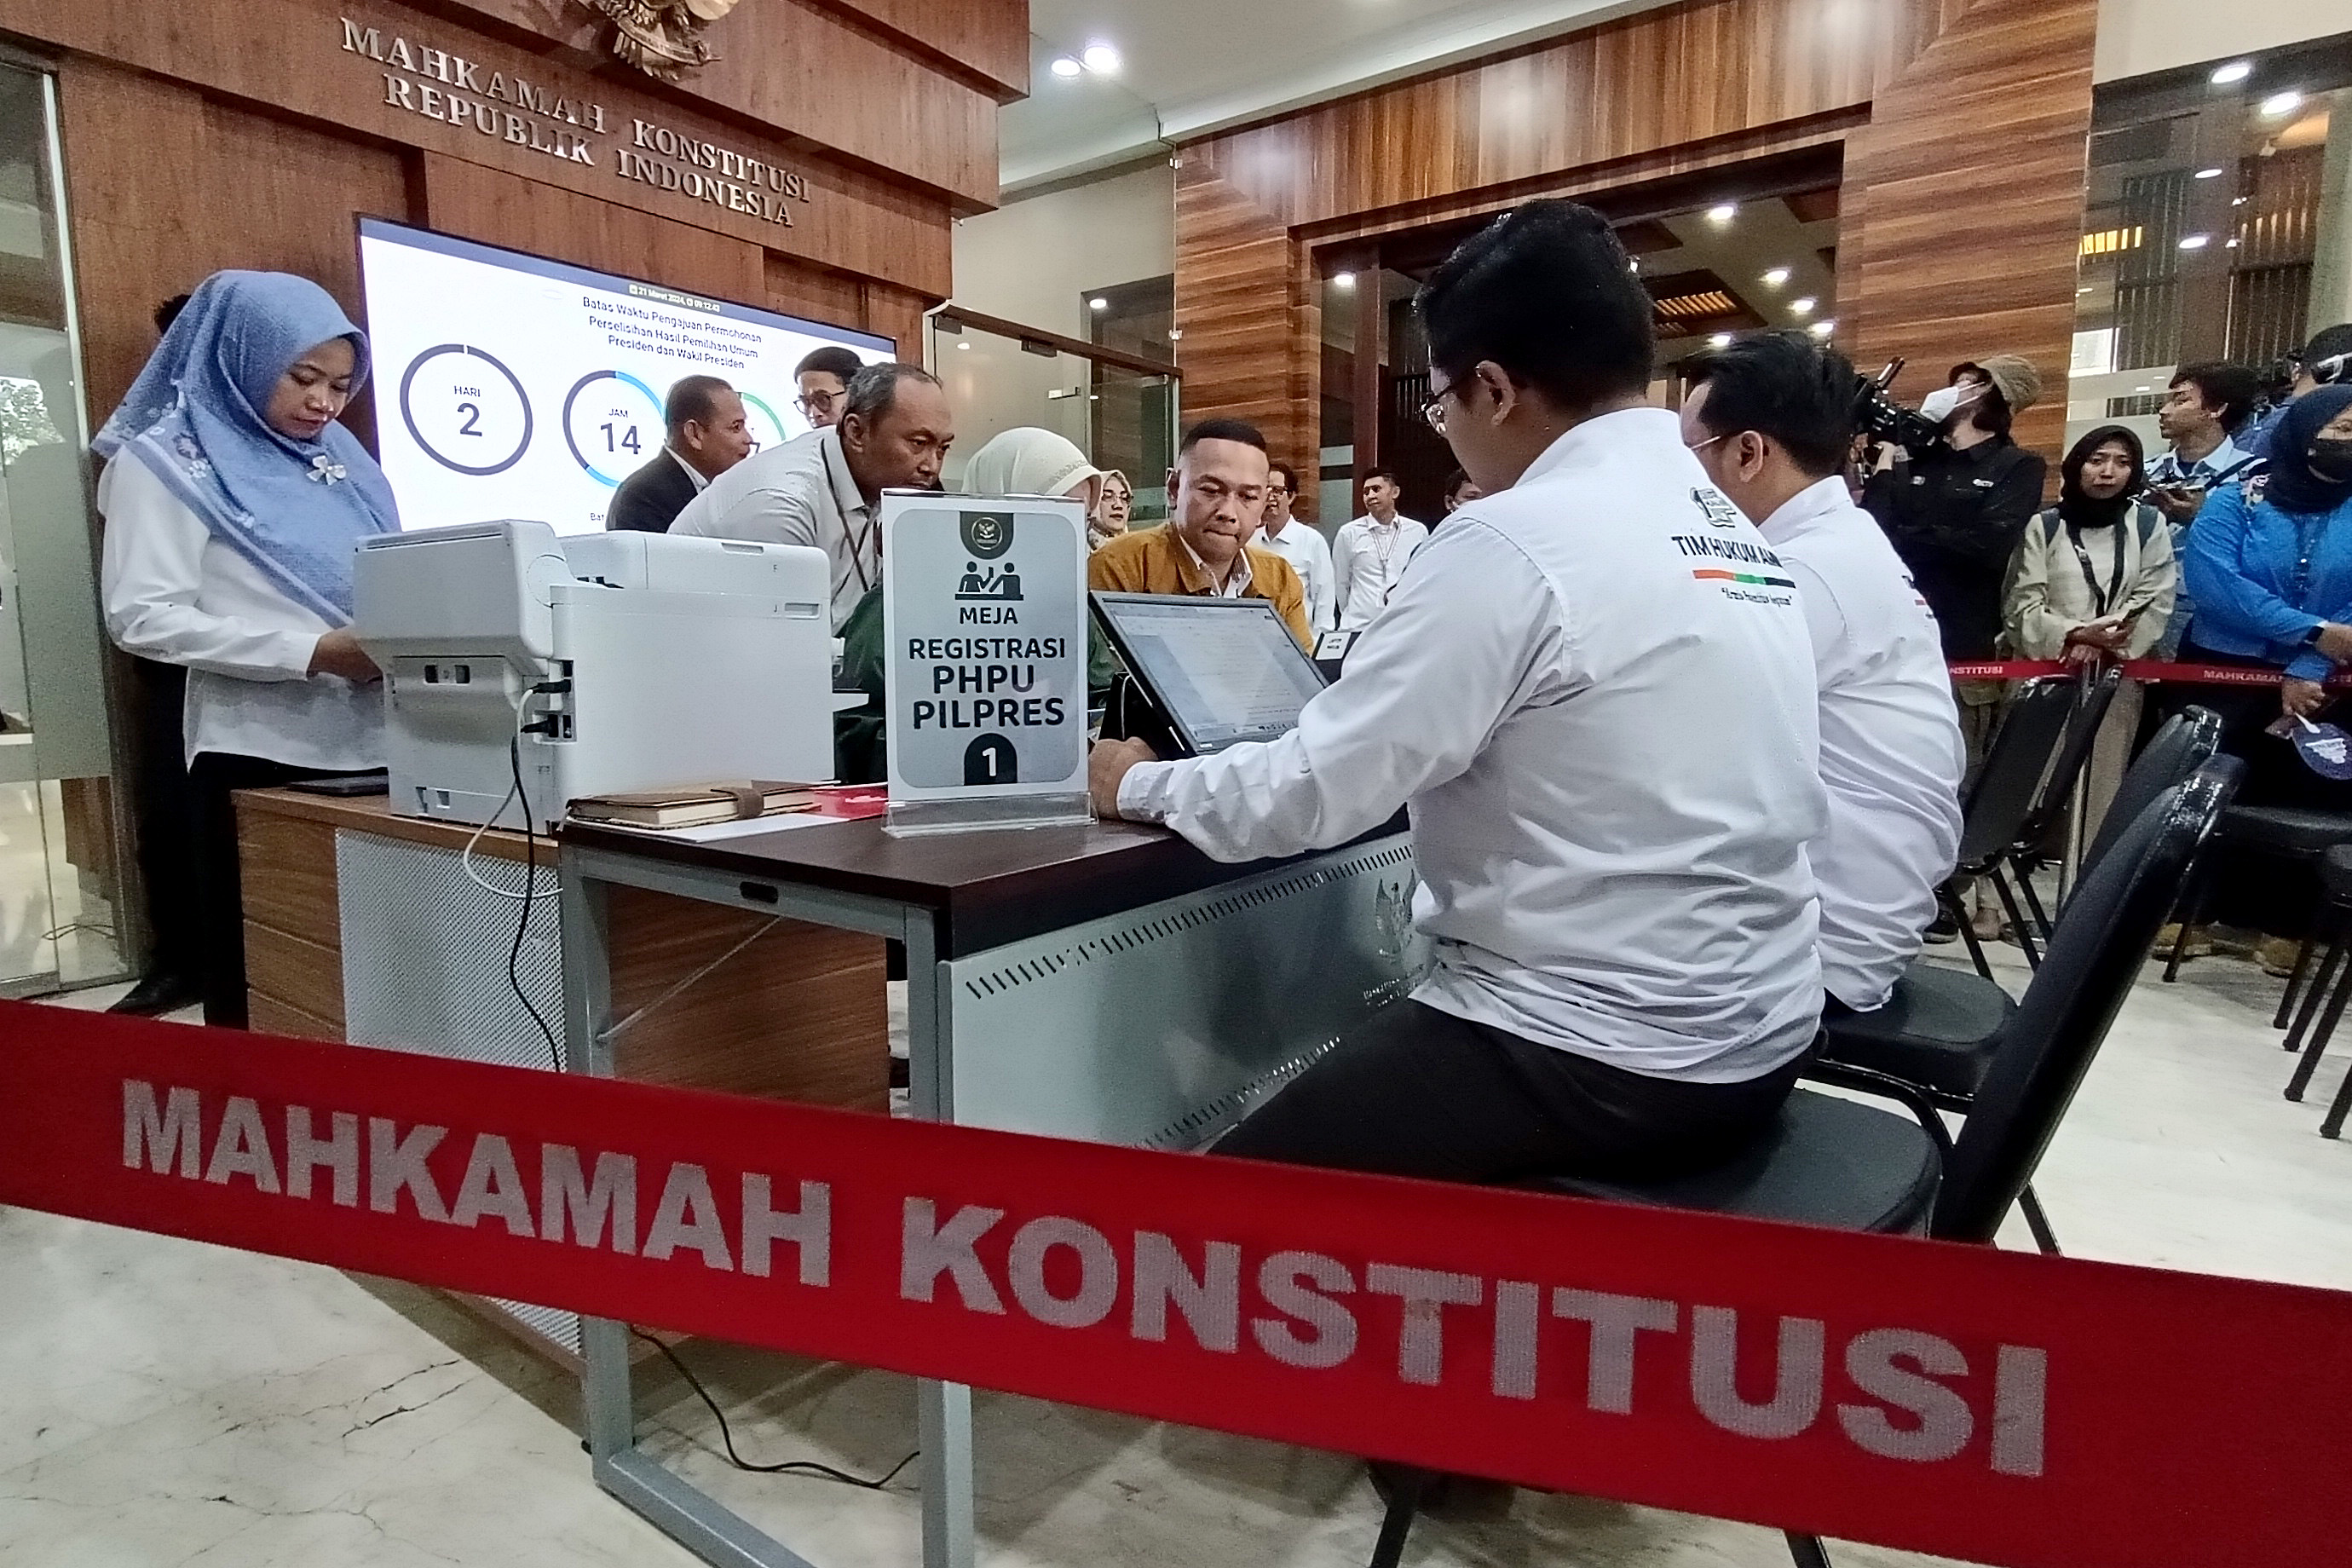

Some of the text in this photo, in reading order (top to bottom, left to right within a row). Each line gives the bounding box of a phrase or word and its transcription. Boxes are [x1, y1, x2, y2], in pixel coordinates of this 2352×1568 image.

[342, 17, 810, 203] MAHKAMAH KONSTITUSI
[383, 73, 793, 227] REPUBLIK INDONESIA
[583, 297, 761, 343] Batas Waktu Pengajuan Permohonan
[589, 315, 758, 358] Perselisihan Hasil Pemilihan Umum
[608, 335, 744, 369] Presiden dan Wakil Presiden
[453, 385, 481, 397] HARI
[457, 402, 482, 436] 2
[608, 408, 628, 418] JAM
[600, 423, 641, 454] 14
[1671, 536, 1711, 556] TIM
[1708, 537, 1761, 563] HUKUM
[960, 607, 1018, 625] MEJA
[909, 637, 1065, 660] REGISTRASI
[933, 665, 1034, 694] PHPU
[914, 697, 1064, 729] PILPRES
[982, 747, 996, 777] 1
[122, 1078, 2047, 1477] MAHKAMAH KONSTITUSI
